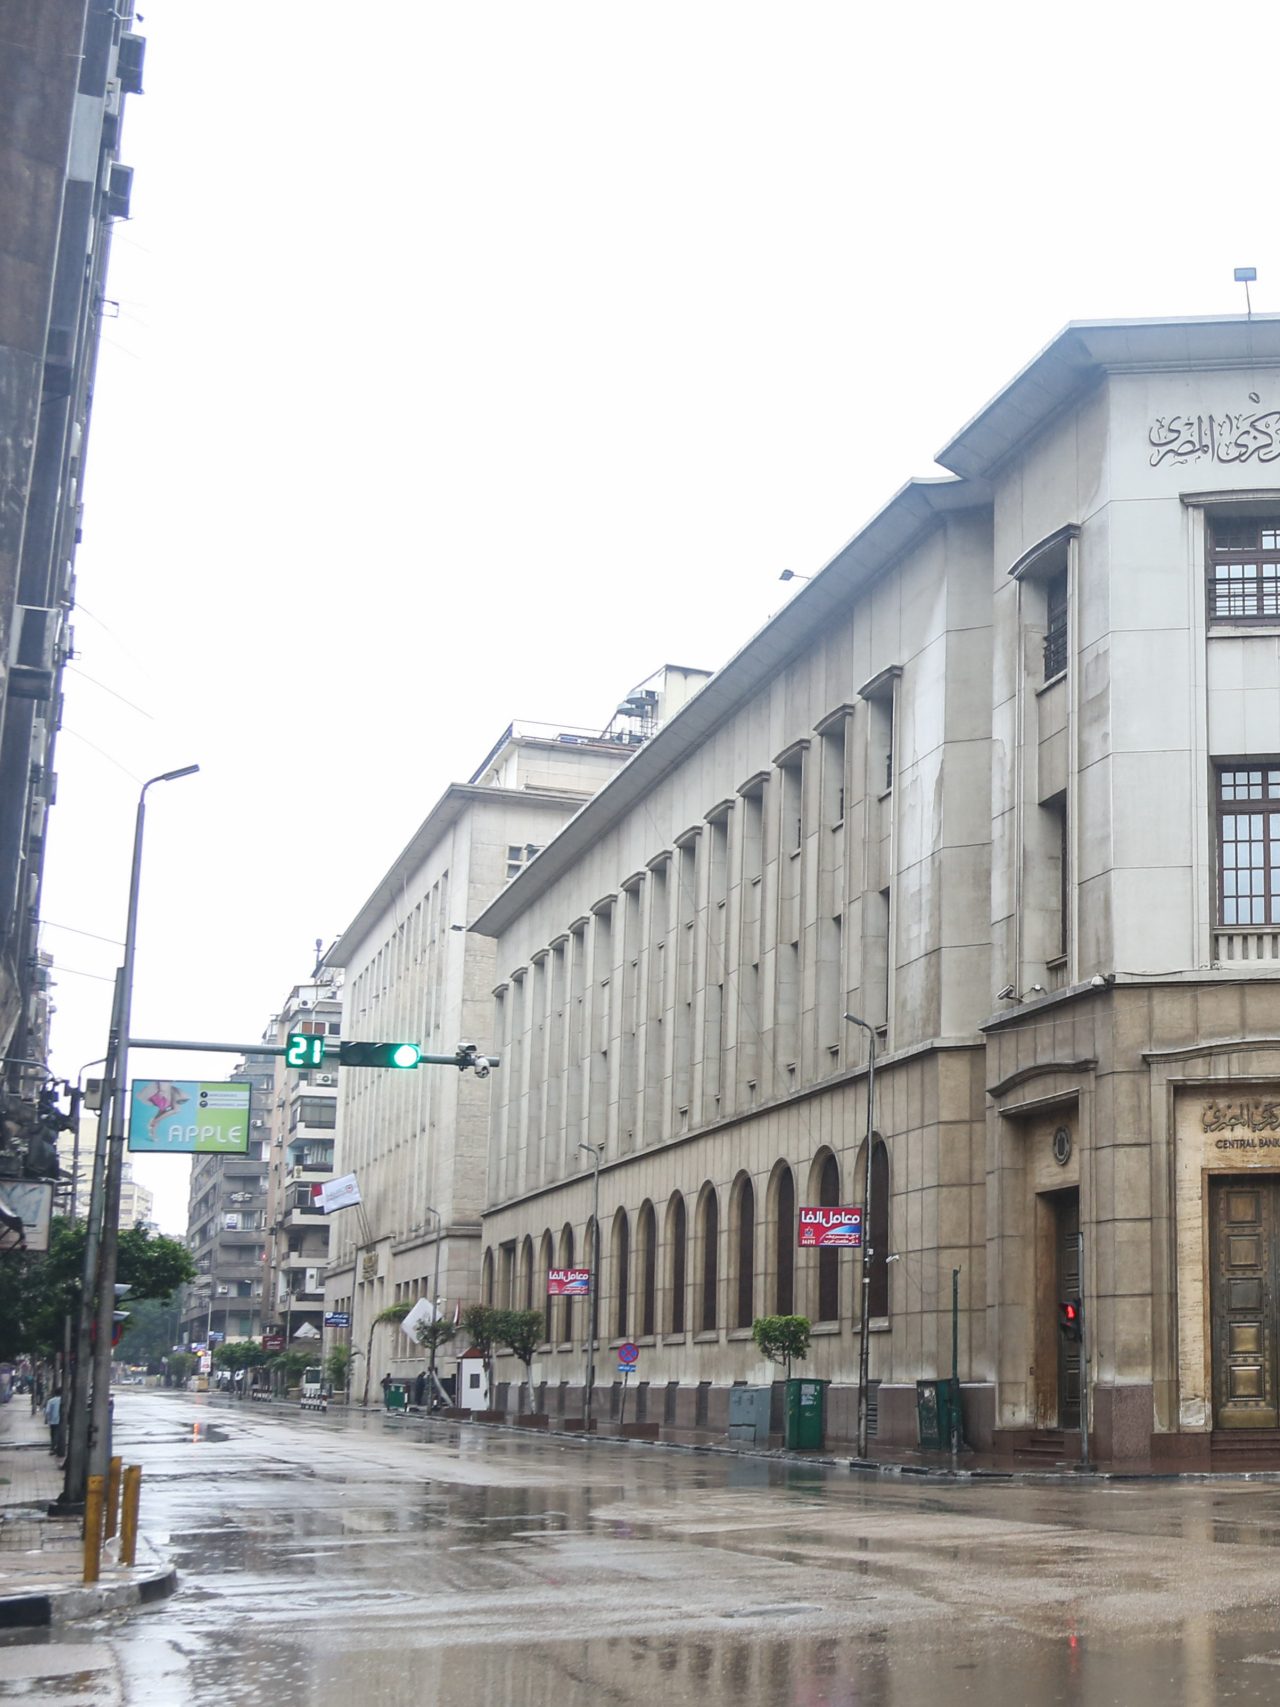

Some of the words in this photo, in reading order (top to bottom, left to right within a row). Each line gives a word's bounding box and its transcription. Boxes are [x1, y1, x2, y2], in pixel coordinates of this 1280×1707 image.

[288, 1036, 321, 1065] 21
[168, 1125, 242, 1143] APPLE
[1215, 1139, 1257, 1149] CENTRAL
[1259, 1138, 1280, 1148] BANK
[801, 1210, 823, 1223] الفا
[822, 1211, 860, 1227] معامل
[563, 1271, 589, 1282] معامل
